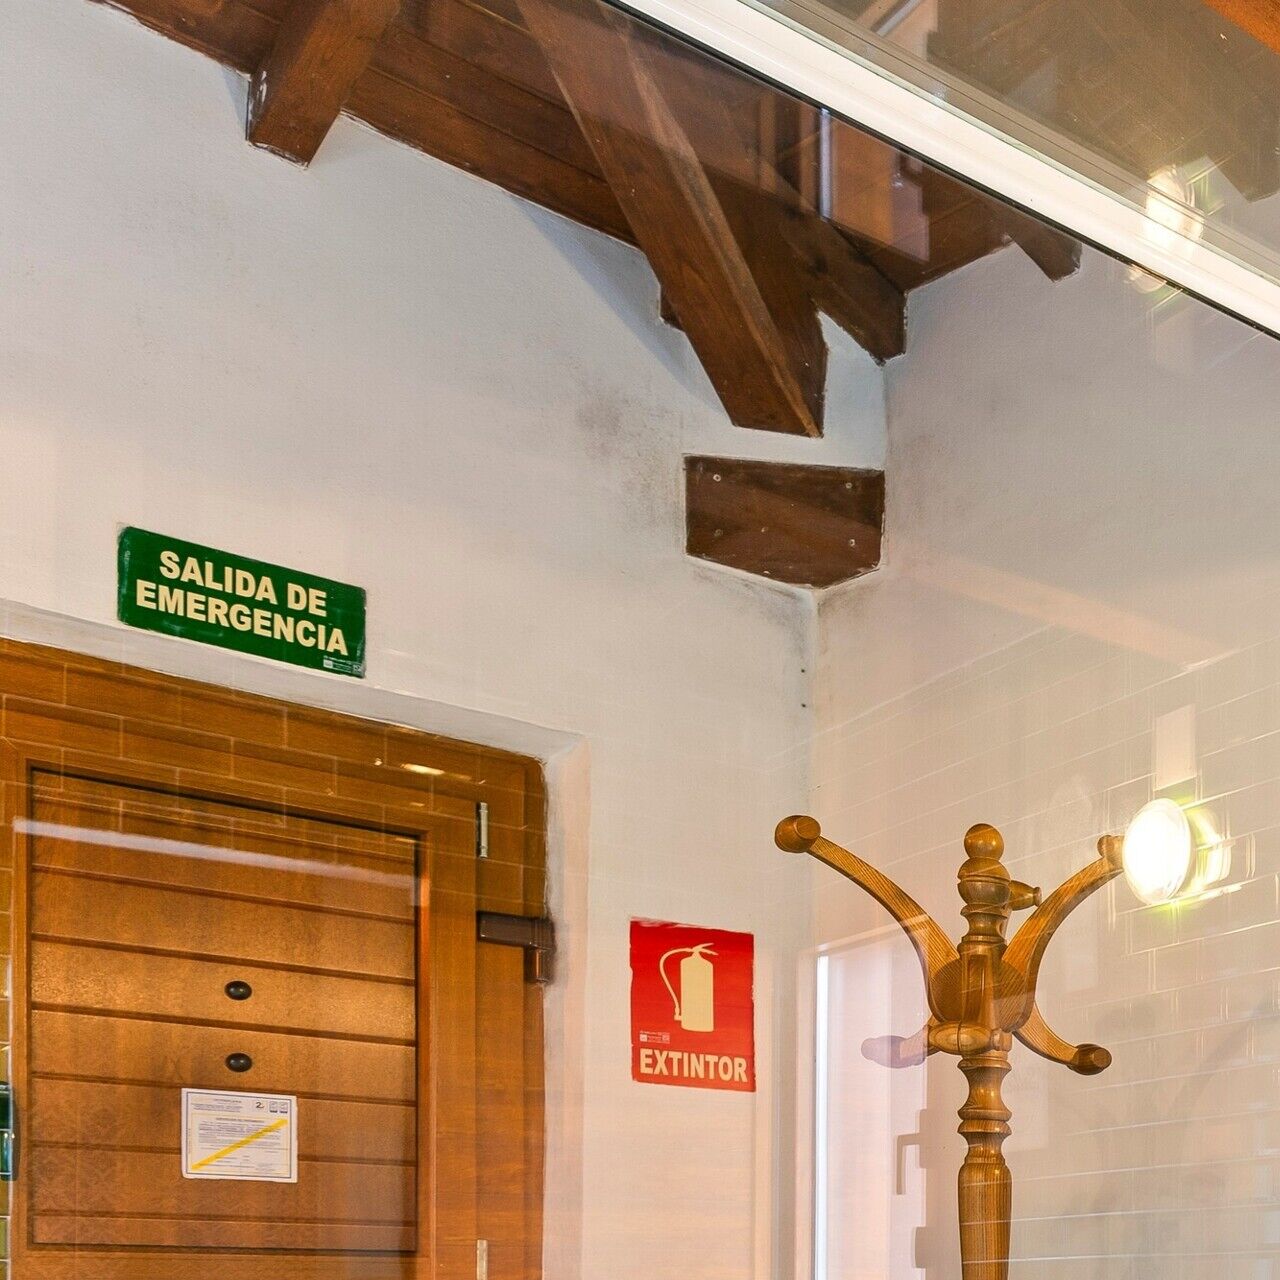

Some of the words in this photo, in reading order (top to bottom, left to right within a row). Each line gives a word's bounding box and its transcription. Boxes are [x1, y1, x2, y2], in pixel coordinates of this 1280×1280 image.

[159, 550, 278, 605] SALIDA
[287, 582, 327, 617] DE
[136, 579, 348, 656] EMERGENCIA
[640, 1048, 748, 1083] EXTINTOR
